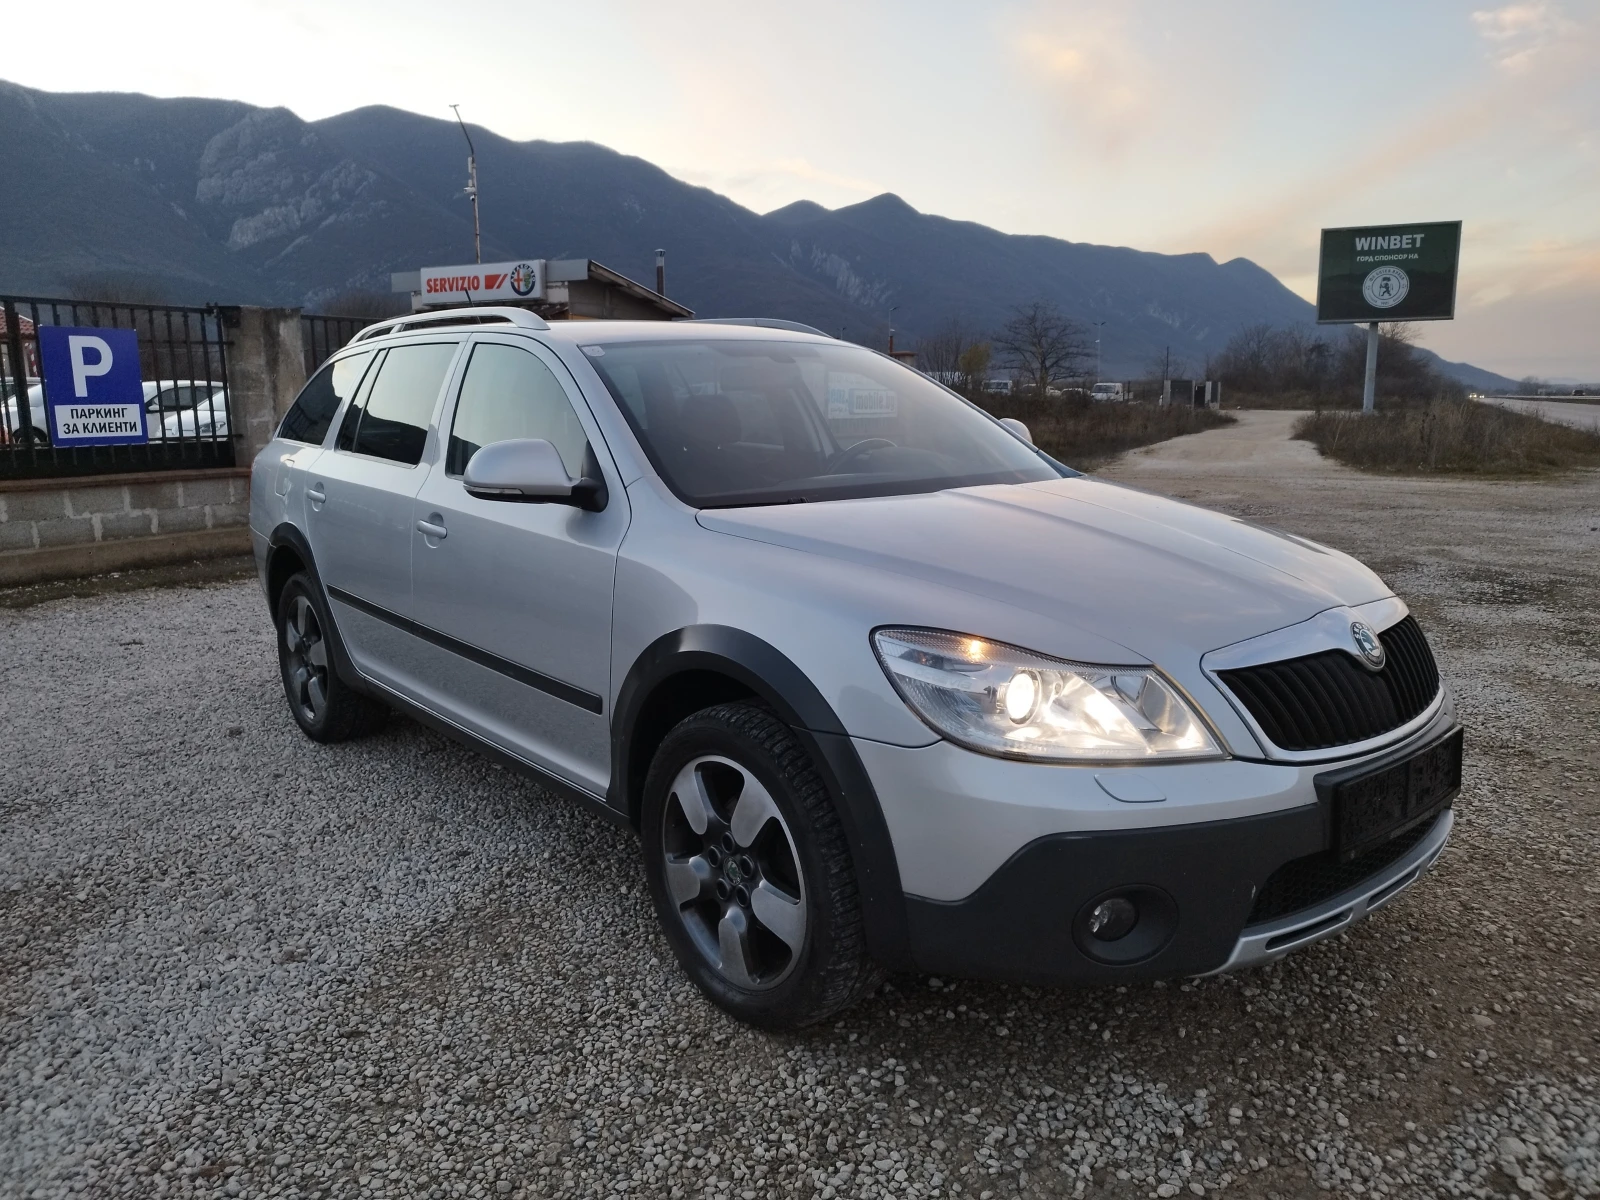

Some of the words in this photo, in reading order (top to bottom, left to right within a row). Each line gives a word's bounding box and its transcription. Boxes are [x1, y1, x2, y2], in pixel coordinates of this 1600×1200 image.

[1355, 234, 1425, 251] WINBET
[426, 275, 481, 294] SERVIZIO
[68, 335, 114, 398] P
[70, 407, 128, 420] ПАРКИНГ
[63, 423, 80, 435] ЗА
[83, 421, 138, 434] КЛИЕНТИ
